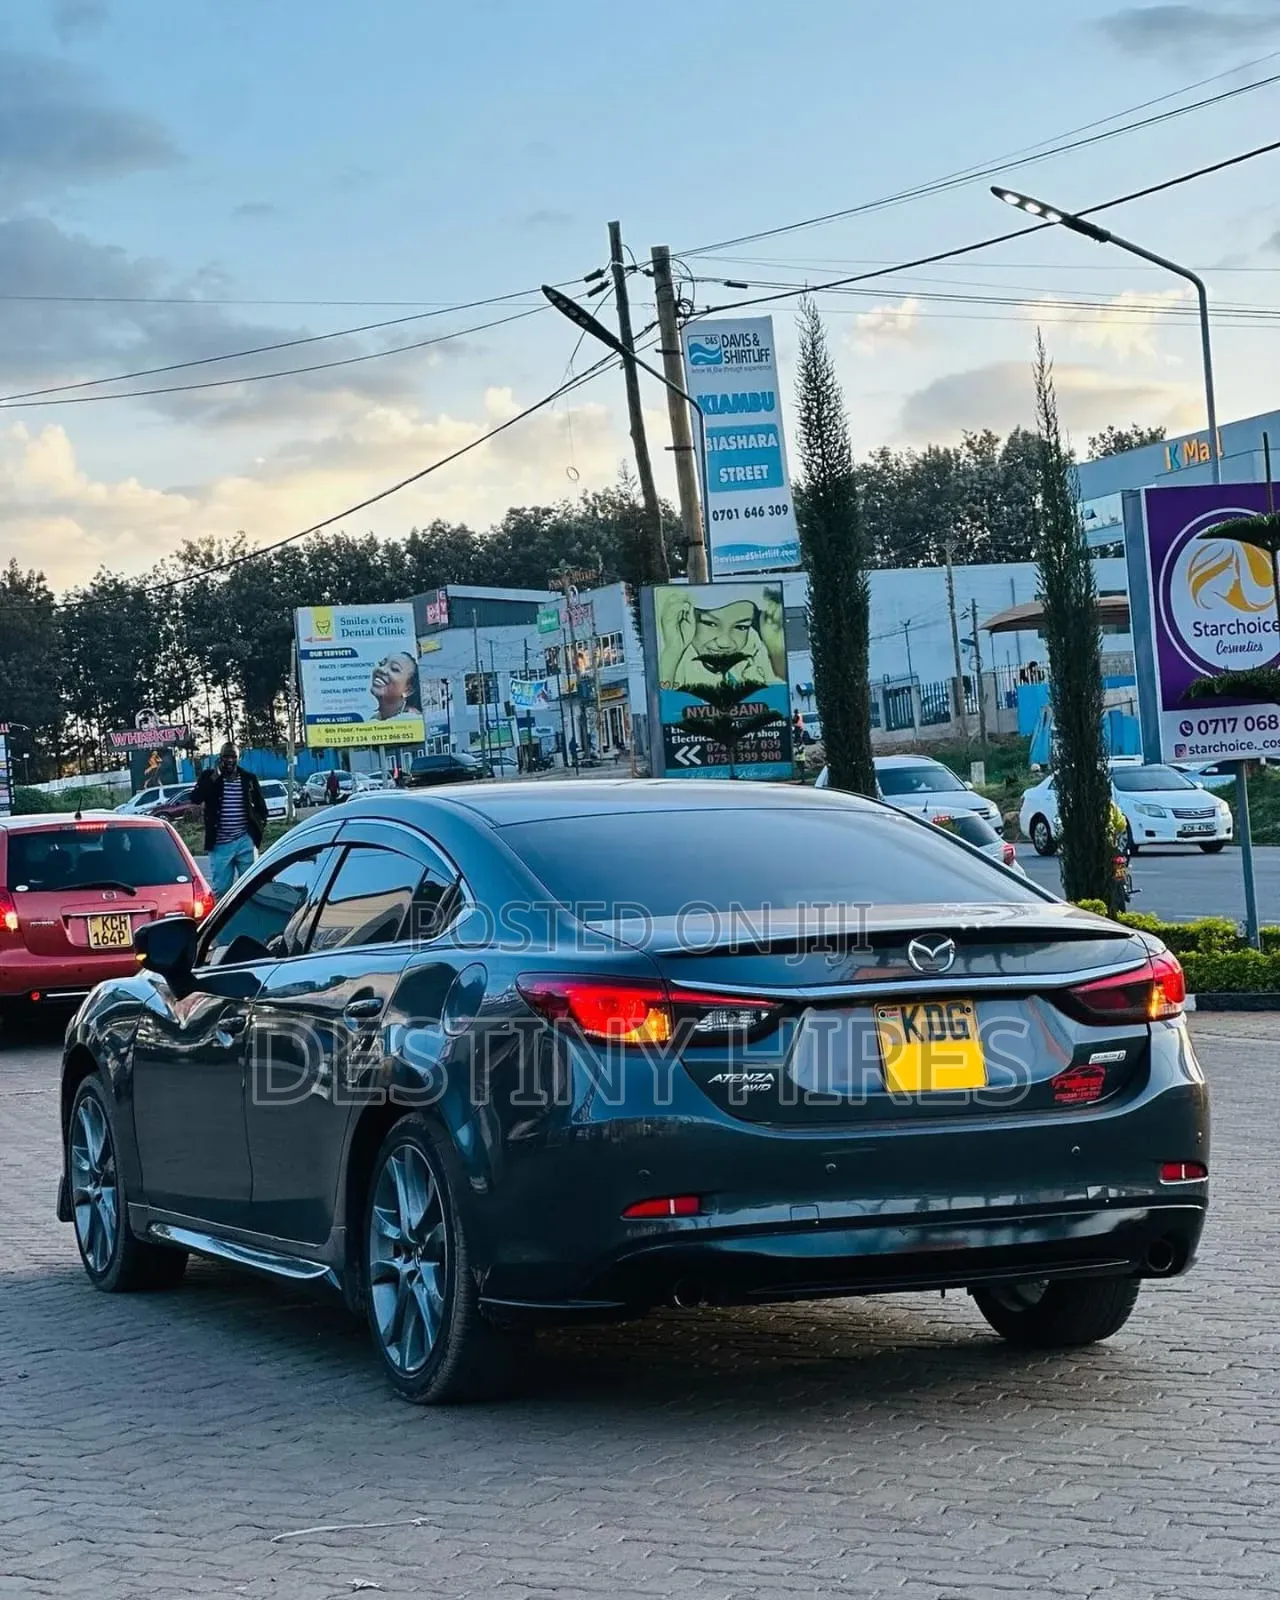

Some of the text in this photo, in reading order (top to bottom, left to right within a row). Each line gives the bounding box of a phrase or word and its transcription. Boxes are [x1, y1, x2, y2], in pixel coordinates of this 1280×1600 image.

[704, 336, 718, 345] D&S
[721, 332, 760, 348] DAVIS &
[723, 348, 770, 364] SHIRTLIFF
[697, 391, 776, 415] KIAMBU
[706, 433, 778, 451] BIASHARA
[1166, 430, 1223, 472] K Mal
[719, 465, 769, 483] STREET
[712, 503, 789, 521] 0701 646 309
[340, 616, 369, 626] Smiles
[379, 615, 405, 625] Grins
[1193, 617, 1280, 637] Starchoice
[341, 626, 407, 638] Dental Clinic
[1216, 639, 1263, 655] Cosmetics
[1197, 713, 1280, 736] 0717 068
[110, 726, 187, 747] WHISKEY
[757, 728, 780, 740] shop
[761, 751, 782, 761] 900
[102, 916, 127, 931] KCH
[94, 932, 125, 946] 164P
[900, 1001, 971, 1043] KDG
[708, 1073, 775, 1083] ATENZA
[738, 1083, 771, 1092] AWD
